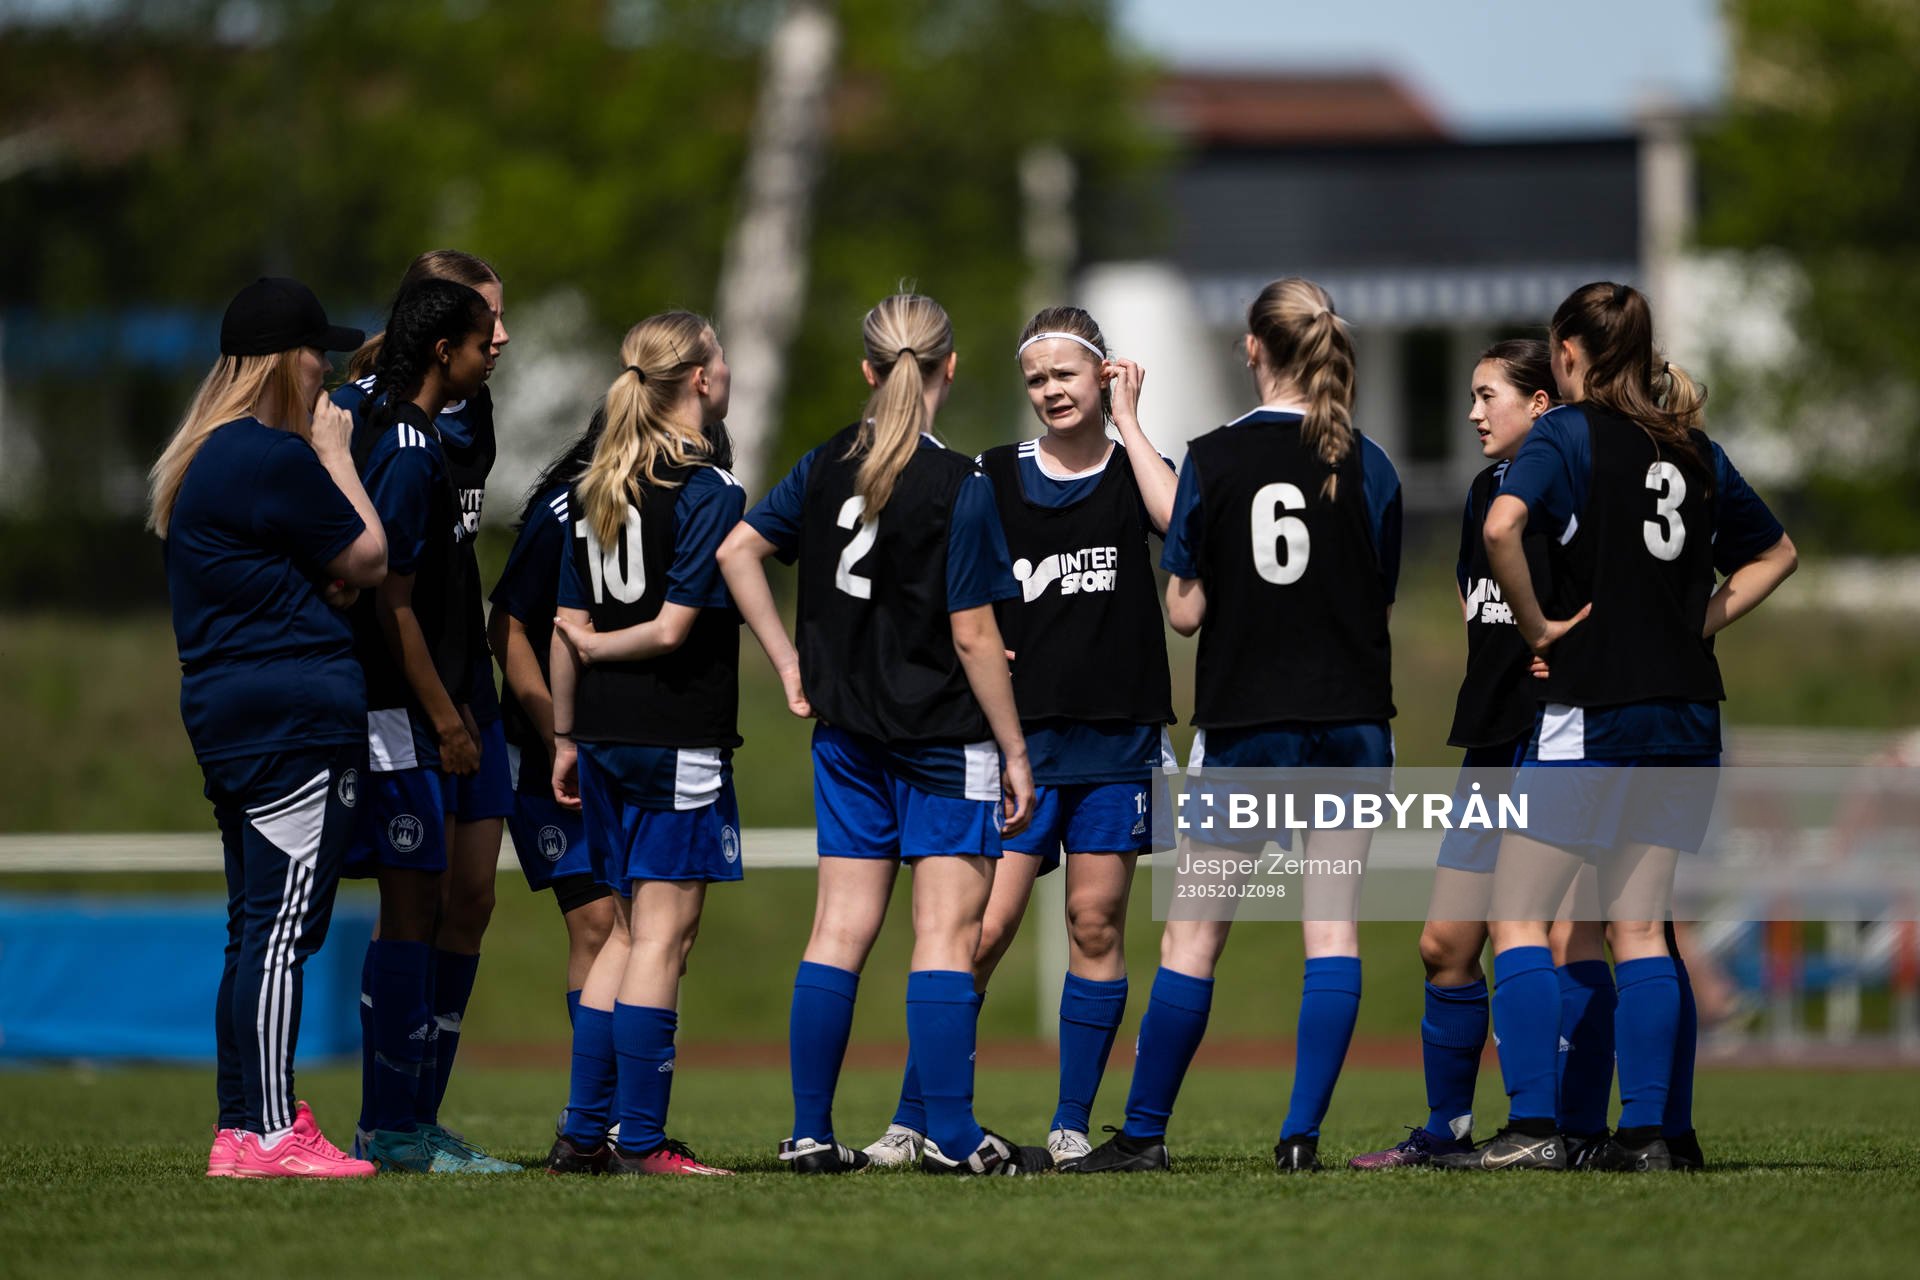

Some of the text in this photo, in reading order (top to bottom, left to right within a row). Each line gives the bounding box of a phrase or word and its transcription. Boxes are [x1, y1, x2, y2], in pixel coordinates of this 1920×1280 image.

[576, 504, 646, 604] 10
[836, 494, 879, 599] 2
[1251, 482, 1310, 585] 6
[1643, 461, 1687, 561] 3
[1060, 547, 1117, 576] INTER
[1061, 569, 1117, 595] SPORT
